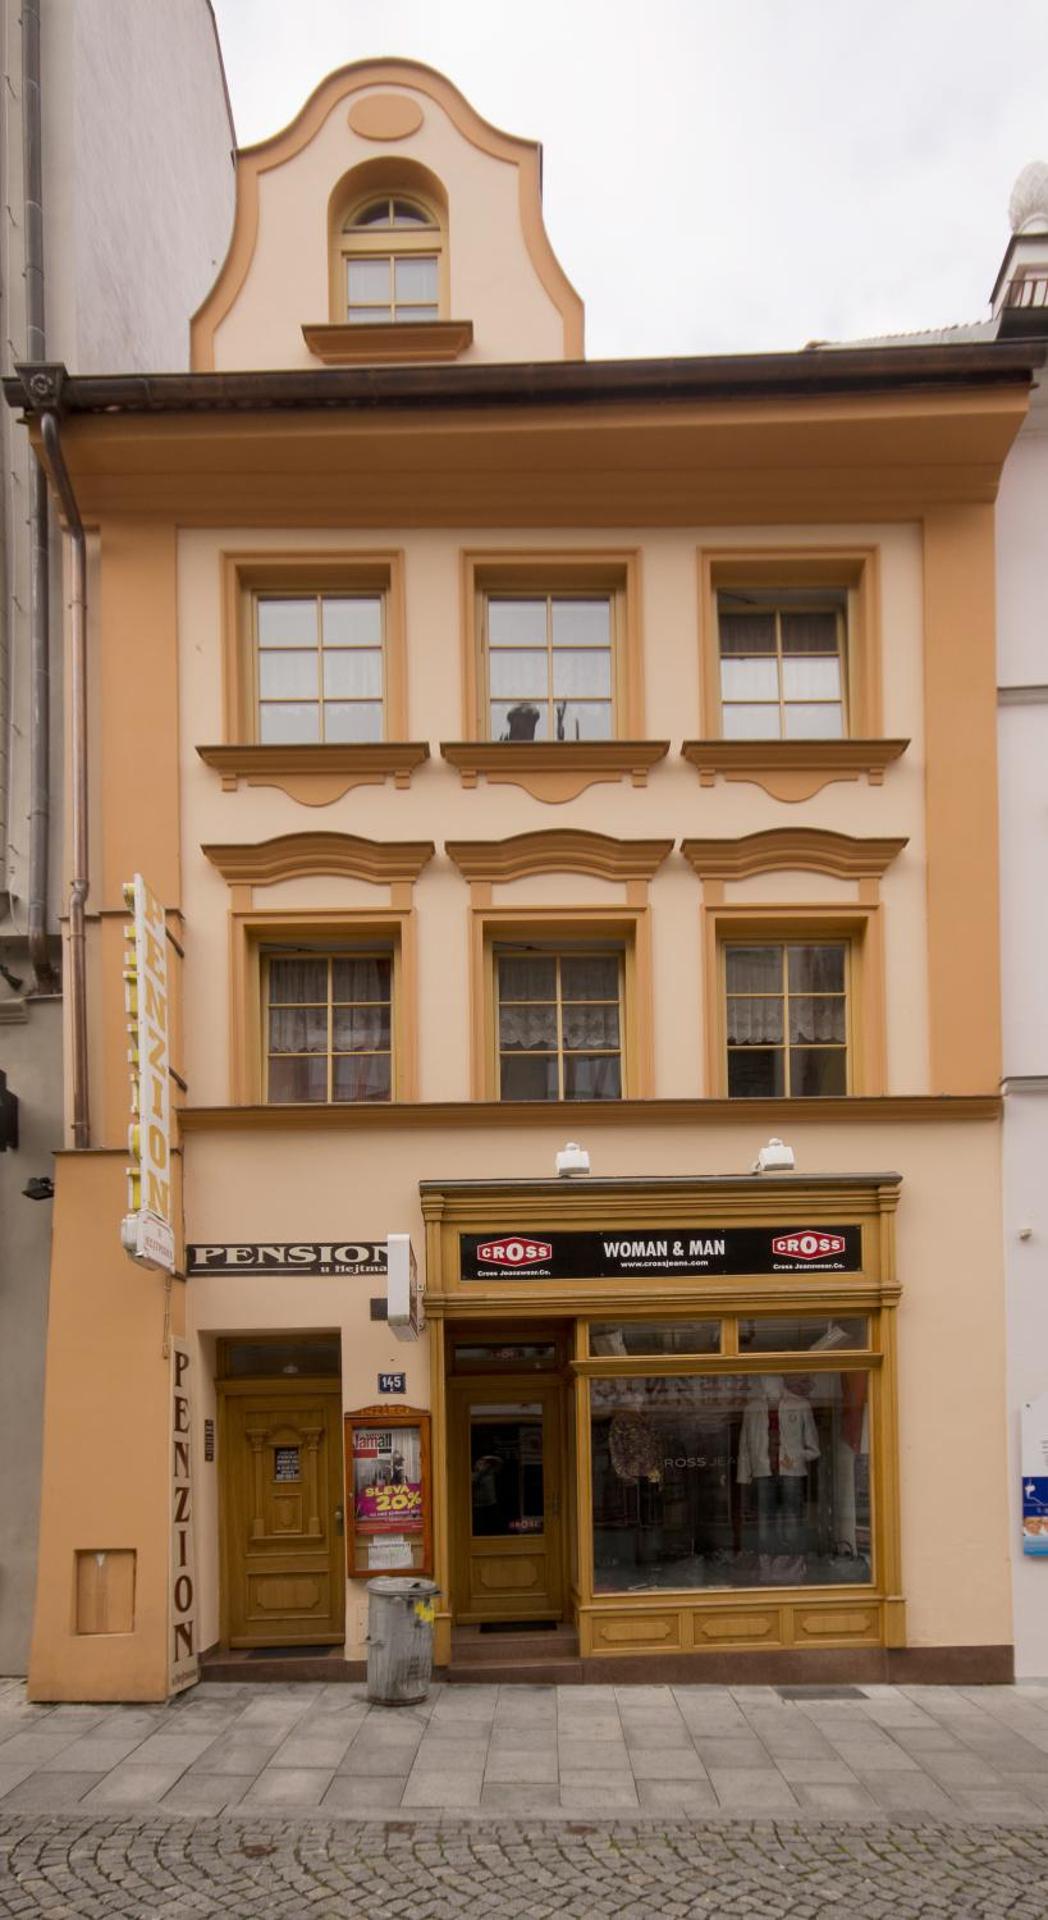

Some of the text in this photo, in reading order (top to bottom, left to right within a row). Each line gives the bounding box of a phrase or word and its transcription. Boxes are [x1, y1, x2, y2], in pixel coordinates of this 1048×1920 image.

[144, 880, 169, 1222] PENZION
[481, 1242, 549, 1261] CROSS
[603, 1239, 726, 1258] WOMAN & MAN
[776, 1236, 841, 1254] CROSS
[320, 1265, 330, 1273] u
[620, 1259, 709, 1268] www.crossjeans.com
[773, 1262, 794, 1270] Cross
[477, 1269, 499, 1277] Cross
[382, 1375, 402, 1388] 145
[365, 1484, 410, 1498] SLEVA
[173, 1350, 194, 1663] PENZION
[376, 1490, 422, 1512] 20%
